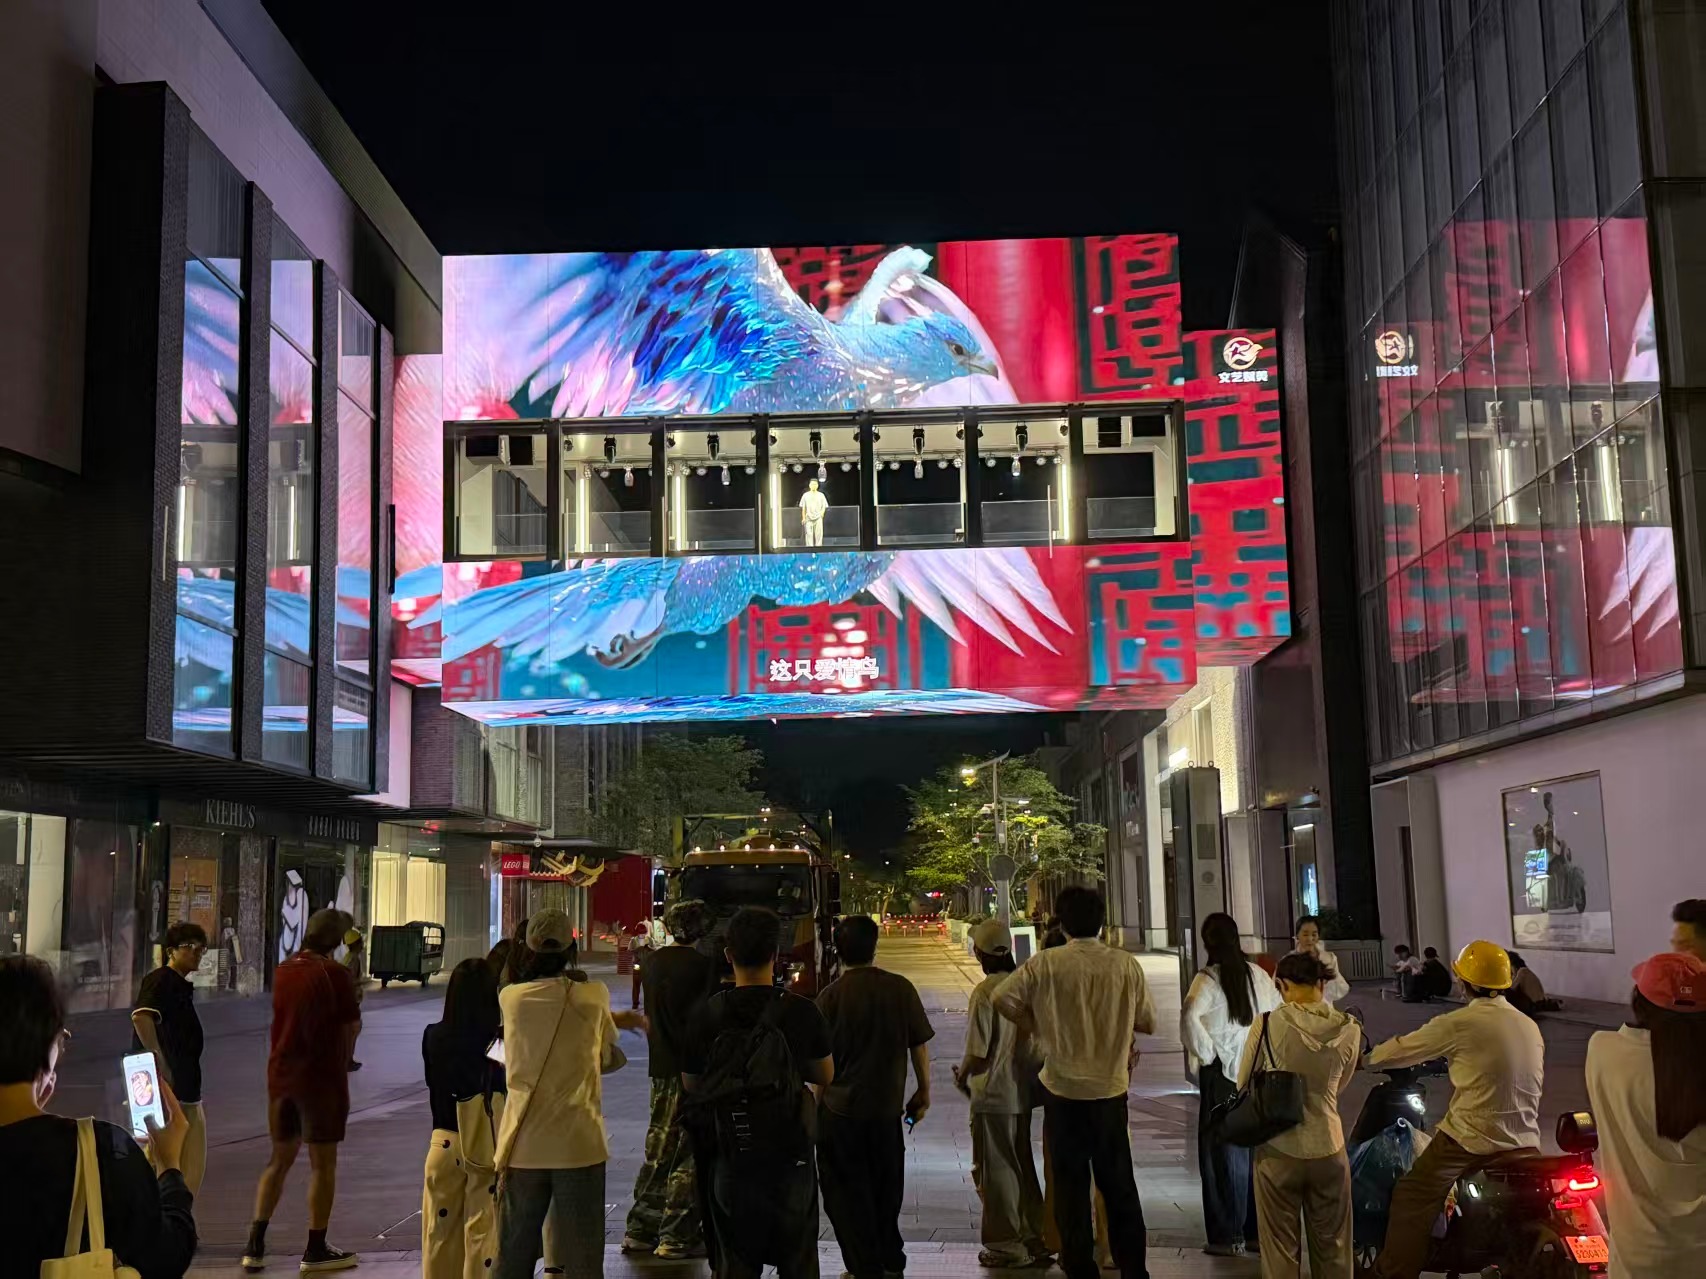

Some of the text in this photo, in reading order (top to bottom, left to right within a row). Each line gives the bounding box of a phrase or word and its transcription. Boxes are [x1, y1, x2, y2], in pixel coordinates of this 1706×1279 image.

[769, 656, 879, 681] 这只爱情鸟
[206, 799, 256, 829] KIEHL'S
